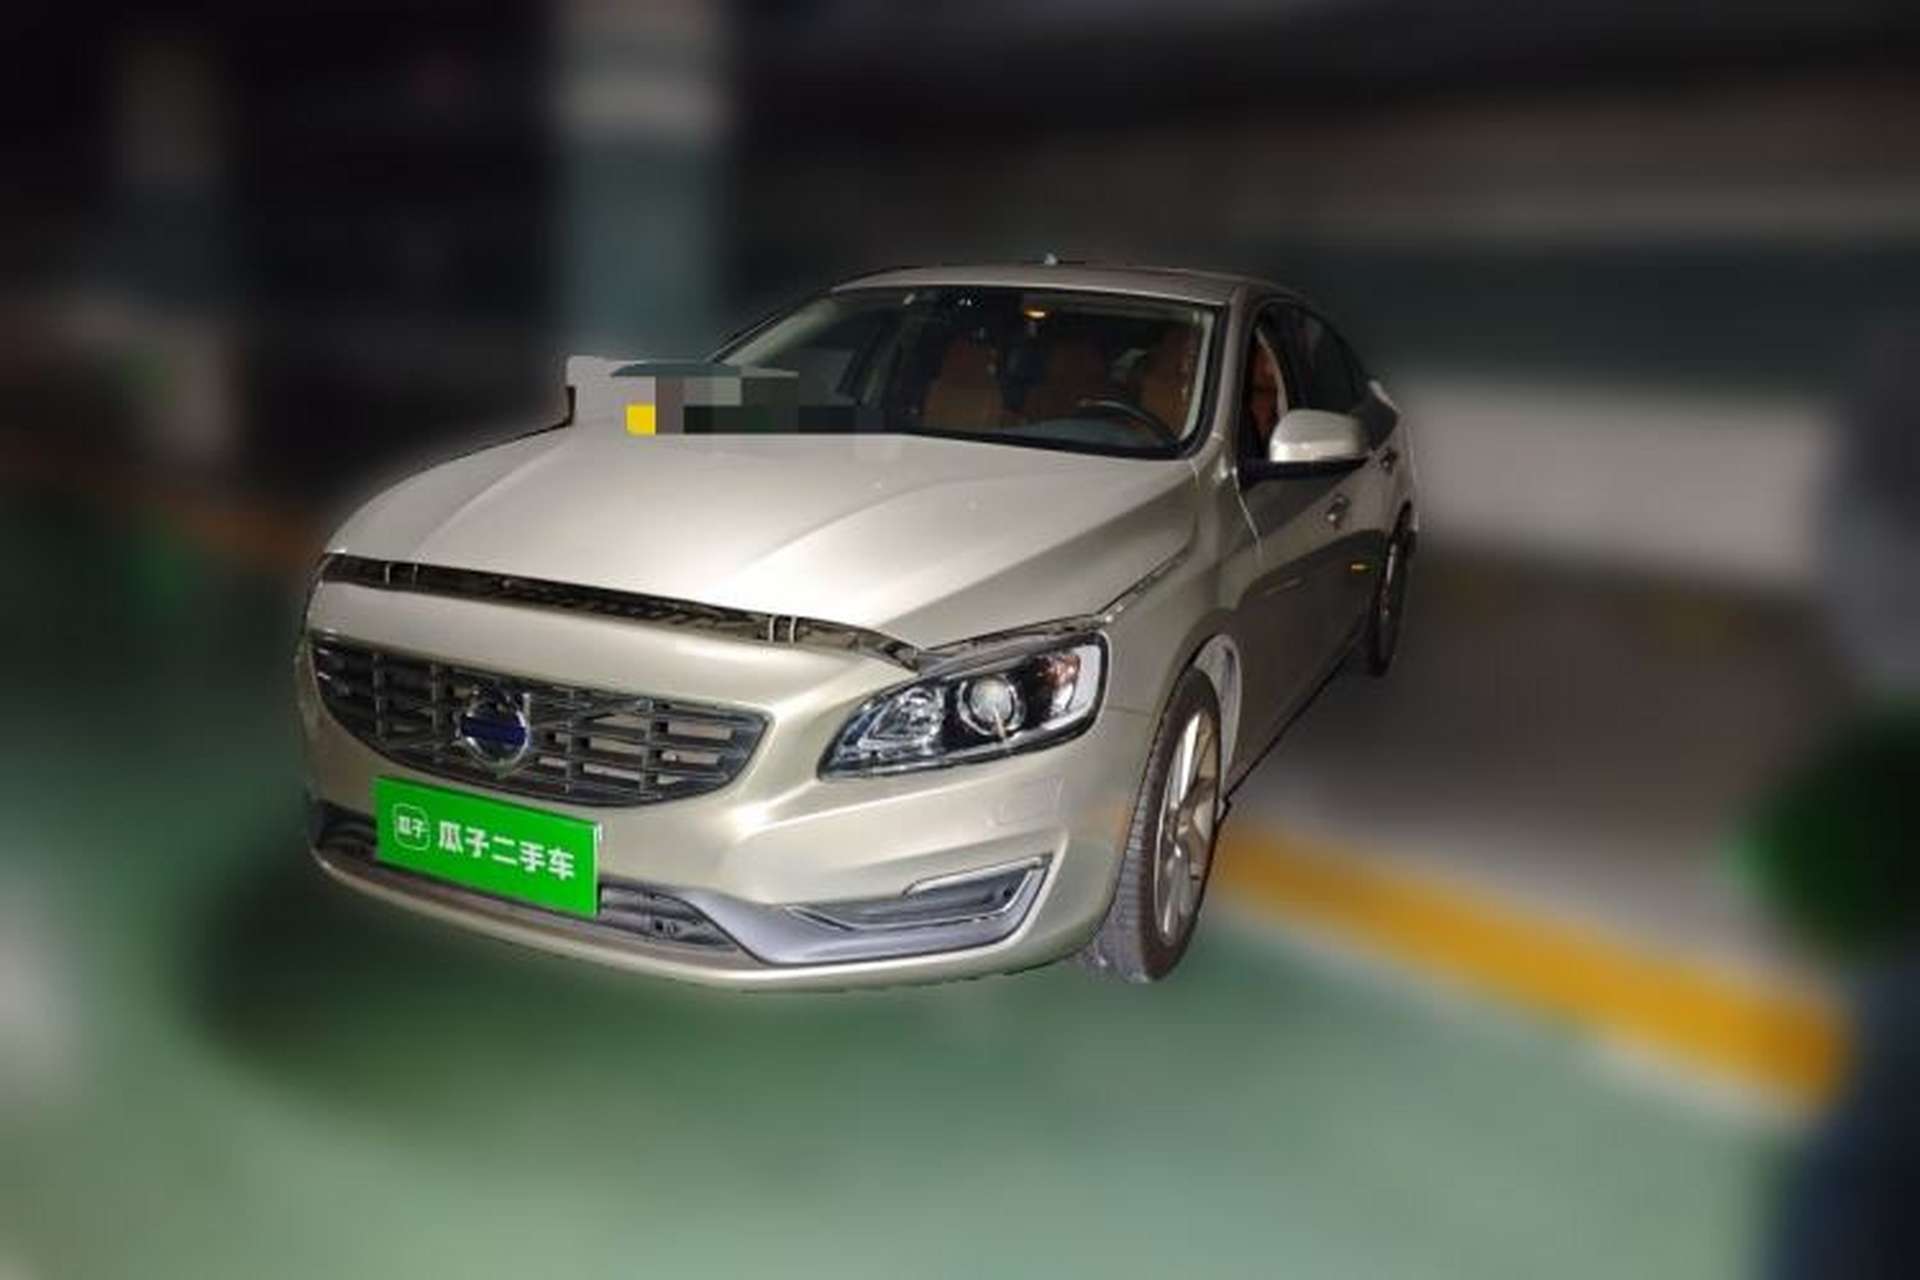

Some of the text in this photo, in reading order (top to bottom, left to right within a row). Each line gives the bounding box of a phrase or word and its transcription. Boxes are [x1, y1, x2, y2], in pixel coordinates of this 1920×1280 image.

[438, 820, 575, 881] 瓜子二手车
